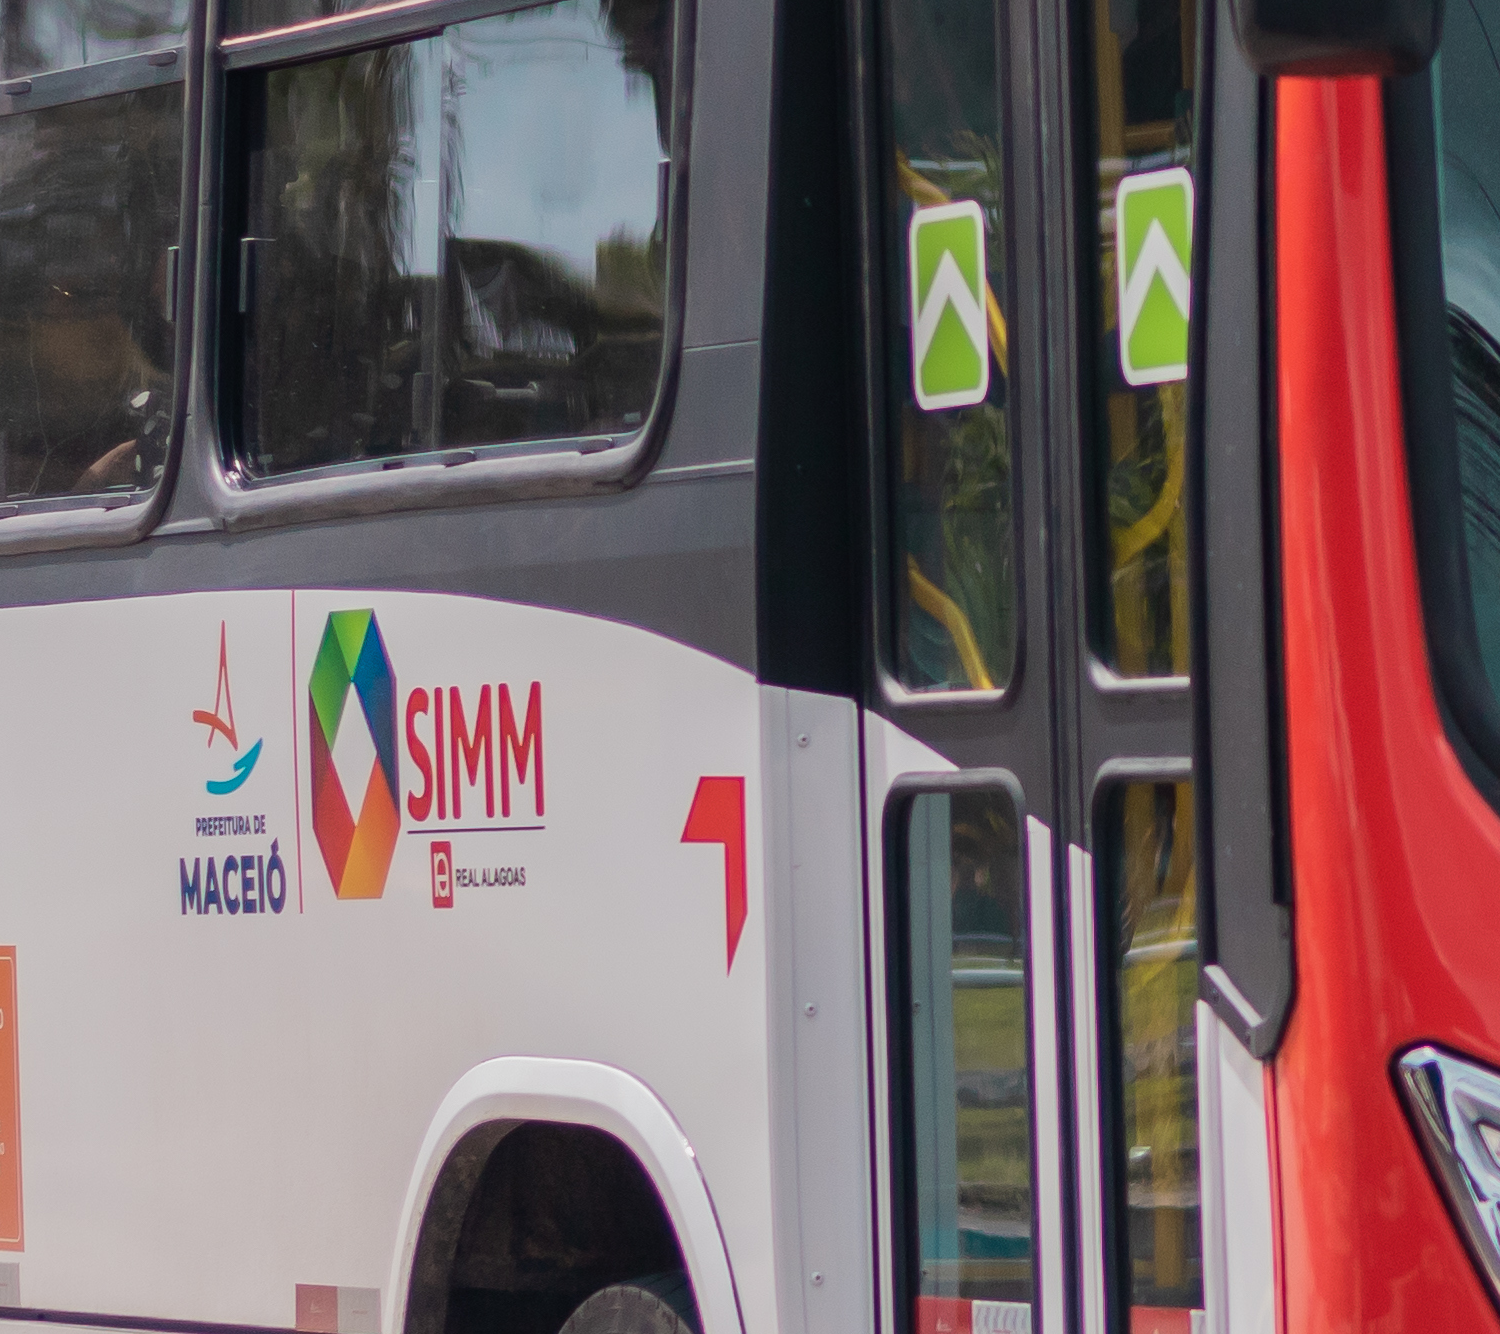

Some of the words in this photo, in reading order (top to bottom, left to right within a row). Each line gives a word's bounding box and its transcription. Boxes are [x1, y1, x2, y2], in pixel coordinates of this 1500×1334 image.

[405, 681, 545, 821] SIMM
[195, 815, 252, 838] PREFEITURA
[253, 814, 267, 836] DE
[180, 838, 288, 916] MACEIÓ
[456, 868, 480, 887] REAL
[481, 866, 526, 887] ALAGOAS
